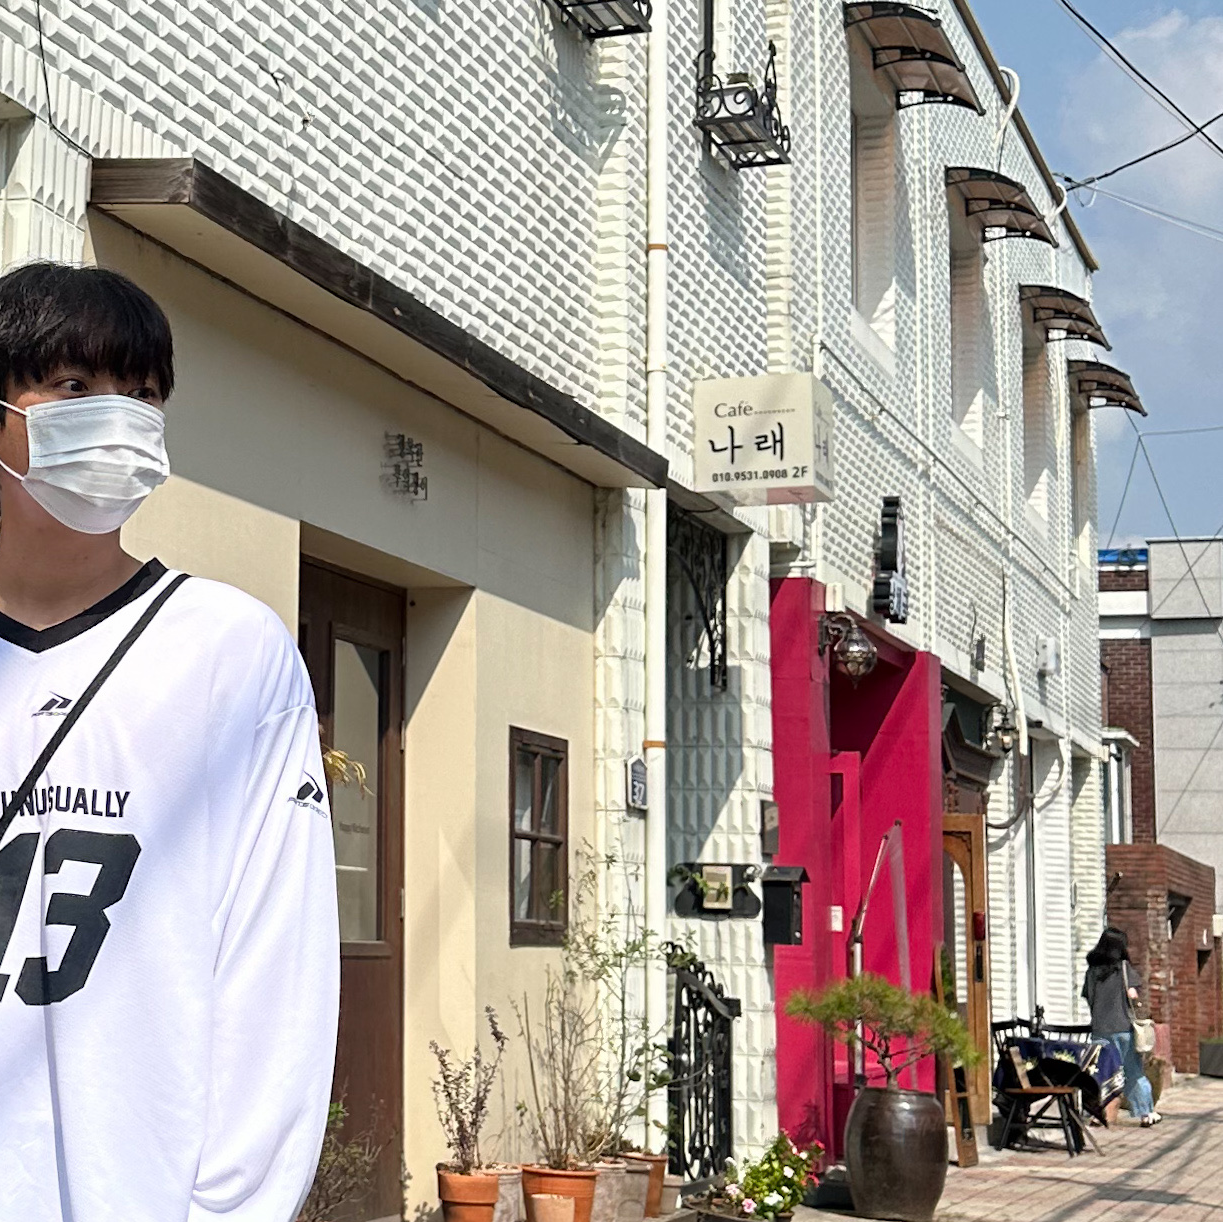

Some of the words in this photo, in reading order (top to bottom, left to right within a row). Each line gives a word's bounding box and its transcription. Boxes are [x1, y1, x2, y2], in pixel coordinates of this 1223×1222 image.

[711, 468, 788, 482] 010.9531.0908
[792, 465, 809, 479] 2F
[633, 780, 645, 804] 37
